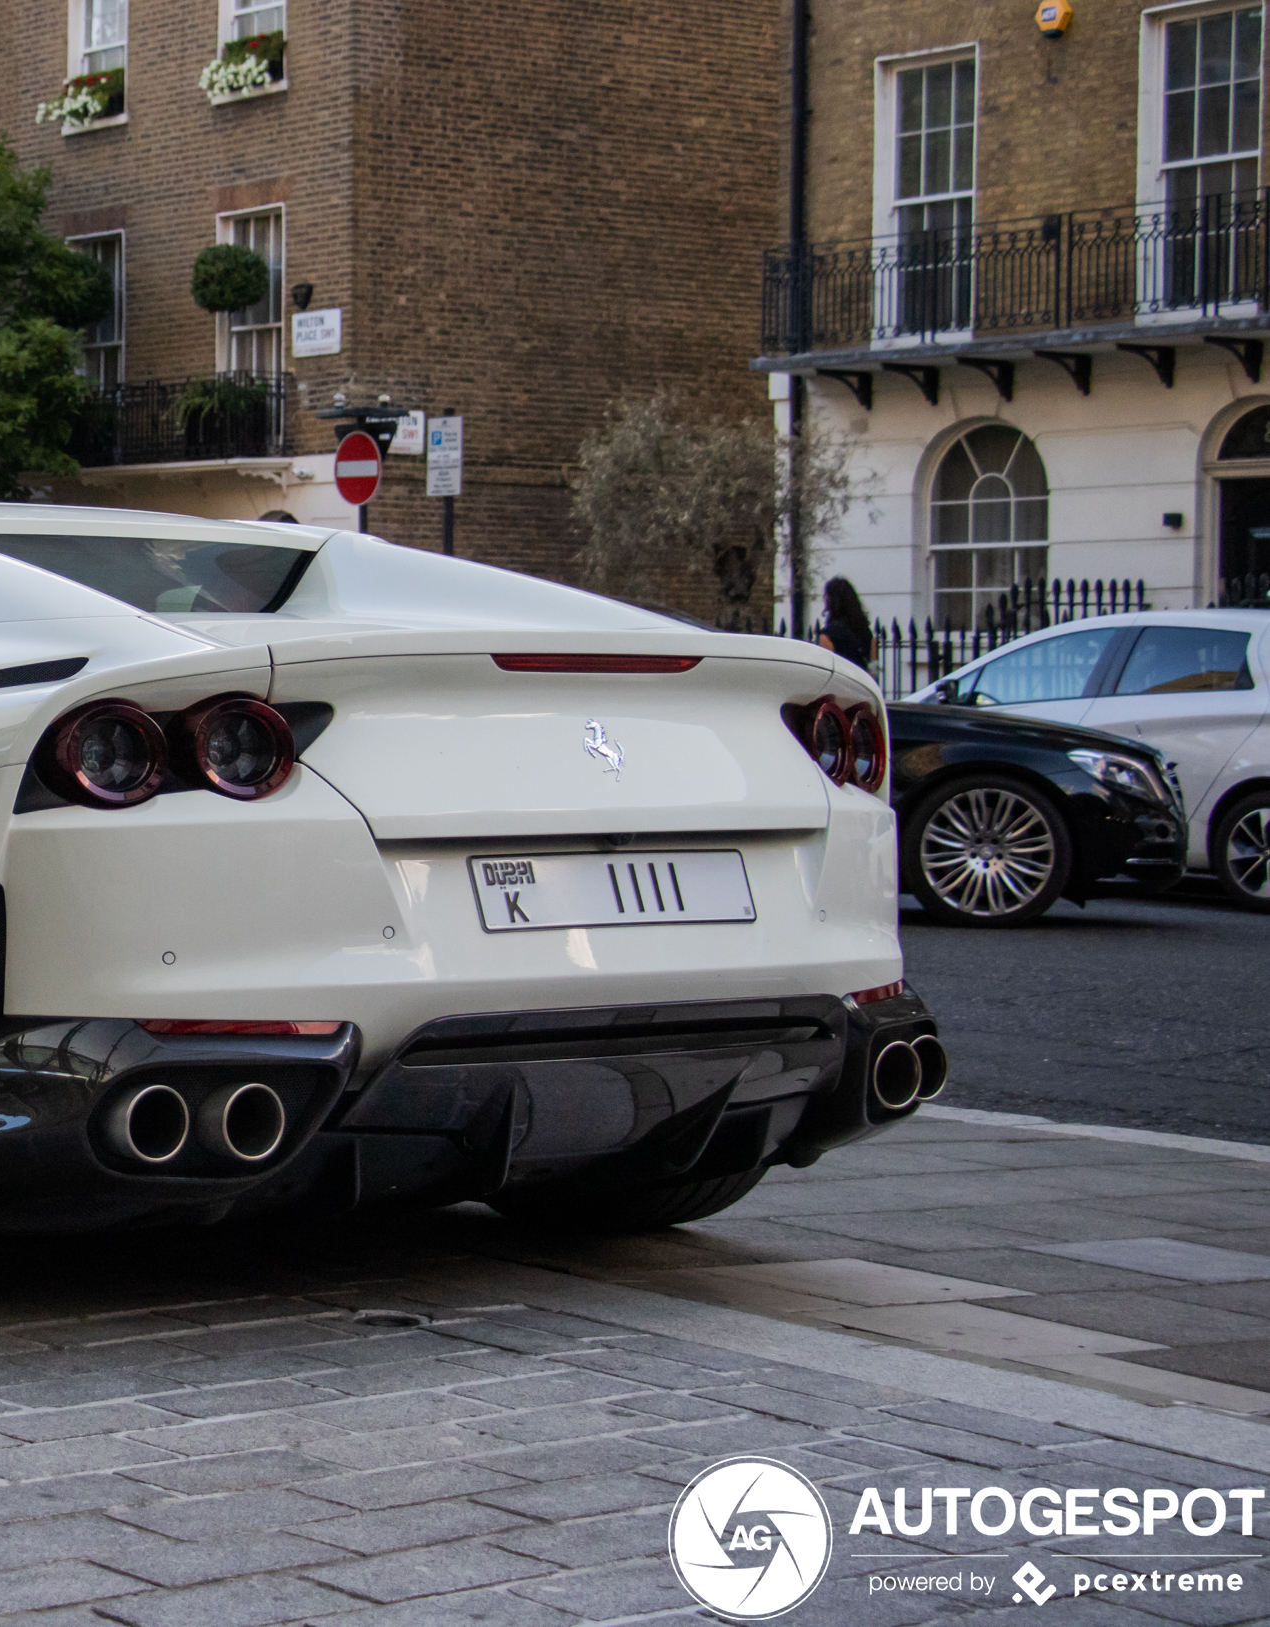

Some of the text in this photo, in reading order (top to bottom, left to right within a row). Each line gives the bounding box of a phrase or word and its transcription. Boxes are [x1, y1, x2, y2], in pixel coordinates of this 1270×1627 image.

[297, 316, 324, 328] WILTON
[296, 328, 334, 342] PLACE SW1
[402, 429, 418, 439] SW1
[607, 862, 685, 913] 1111
[504, 891, 530, 923] K
